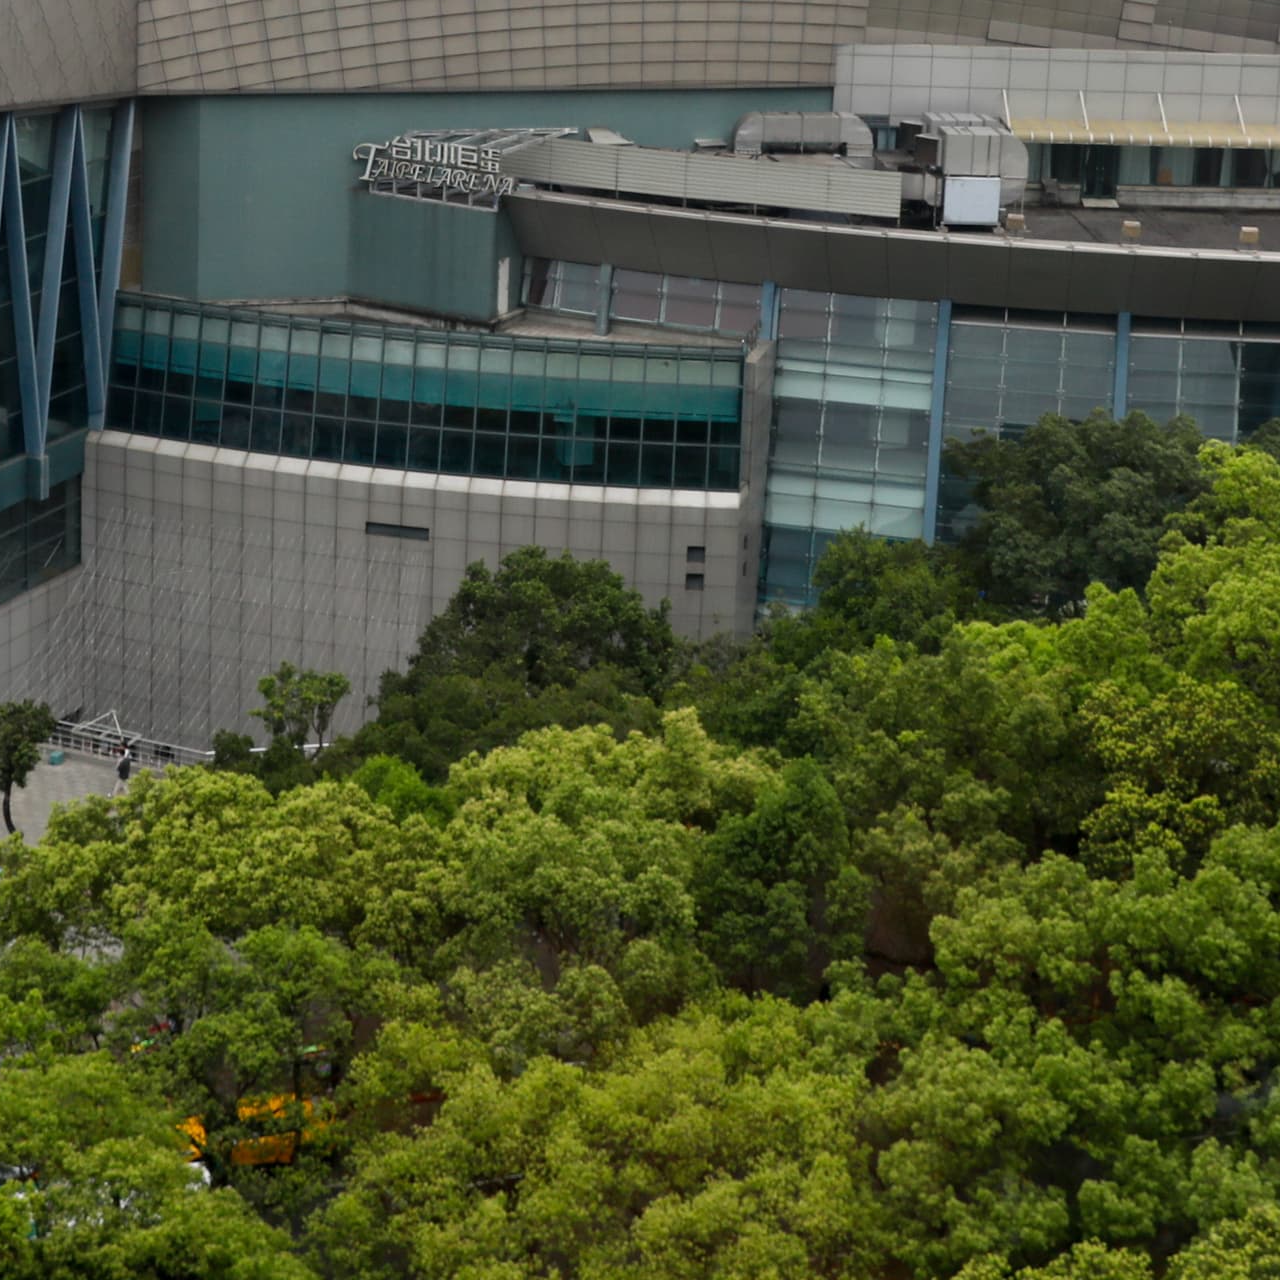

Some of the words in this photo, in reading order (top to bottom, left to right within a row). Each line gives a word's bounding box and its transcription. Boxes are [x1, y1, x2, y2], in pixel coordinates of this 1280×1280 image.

[353, 141, 434, 183] TAIPEI
[433, 167, 515, 196] ARENA
[391, 136, 502, 173] 台北小巨蛋
